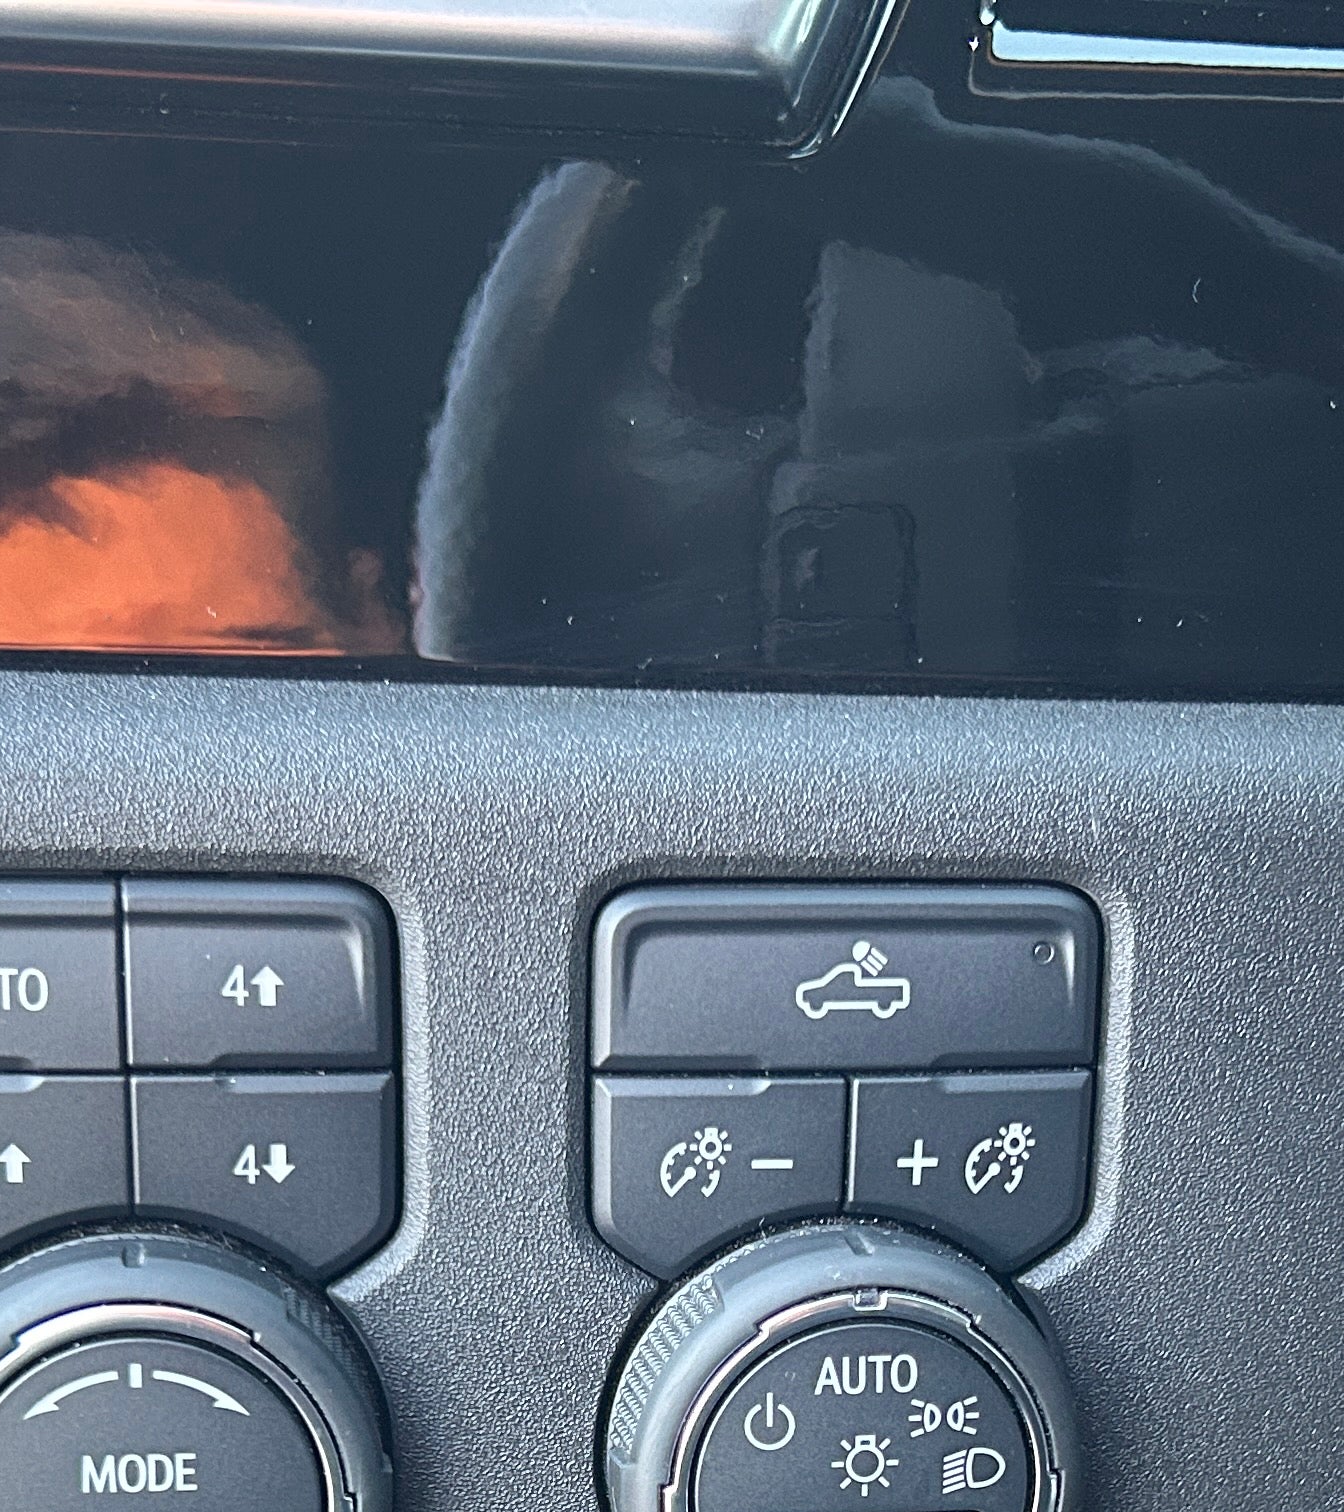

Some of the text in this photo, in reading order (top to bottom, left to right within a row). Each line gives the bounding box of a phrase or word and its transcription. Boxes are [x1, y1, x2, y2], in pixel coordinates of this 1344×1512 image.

[221, 966, 249, 1007] 4
[233, 1145, 259, 1185] 4
[814, 1353, 919, 1396] AUTO
[81, 1452, 198, 1494] MODE
